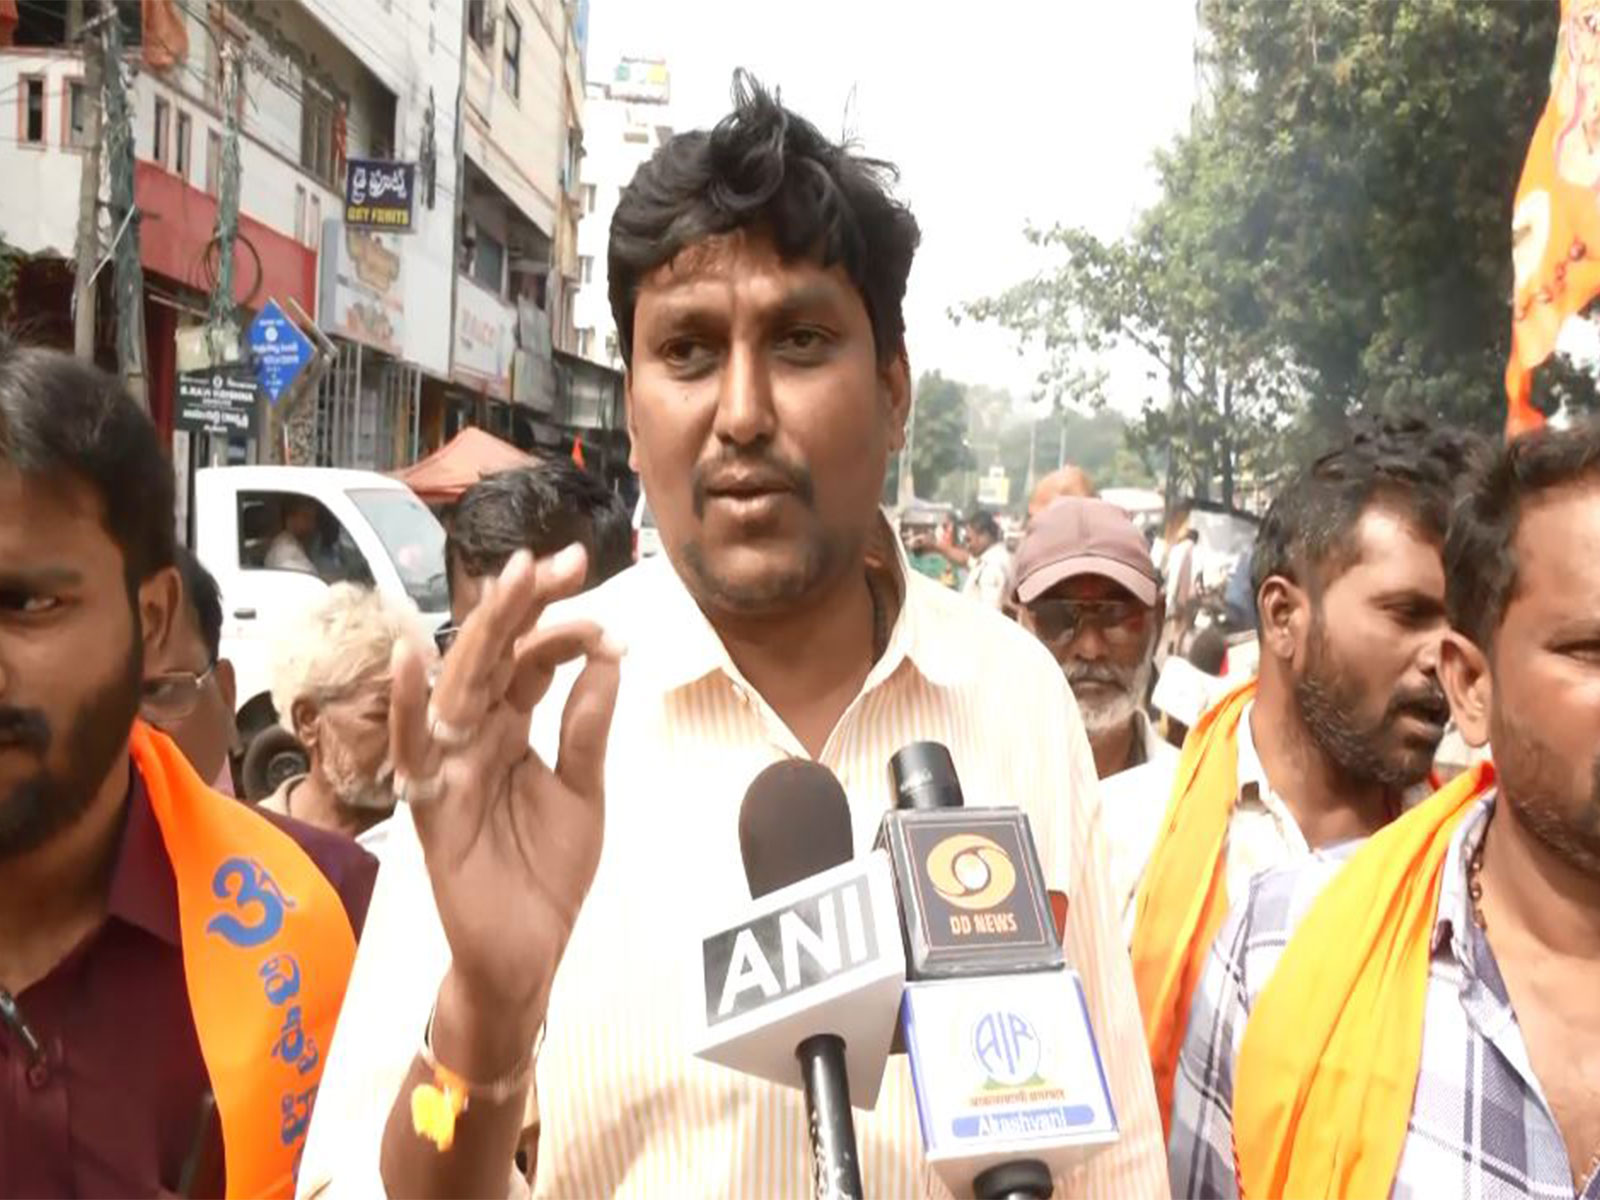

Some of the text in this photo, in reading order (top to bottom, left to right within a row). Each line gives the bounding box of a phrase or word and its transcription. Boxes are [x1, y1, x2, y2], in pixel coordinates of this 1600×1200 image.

[371, 208, 409, 225] FRUITS
[949, 912, 1019, 935] DD NEWS
[716, 884, 868, 1018] ANI
[974, 1011, 1034, 1076] AIR
